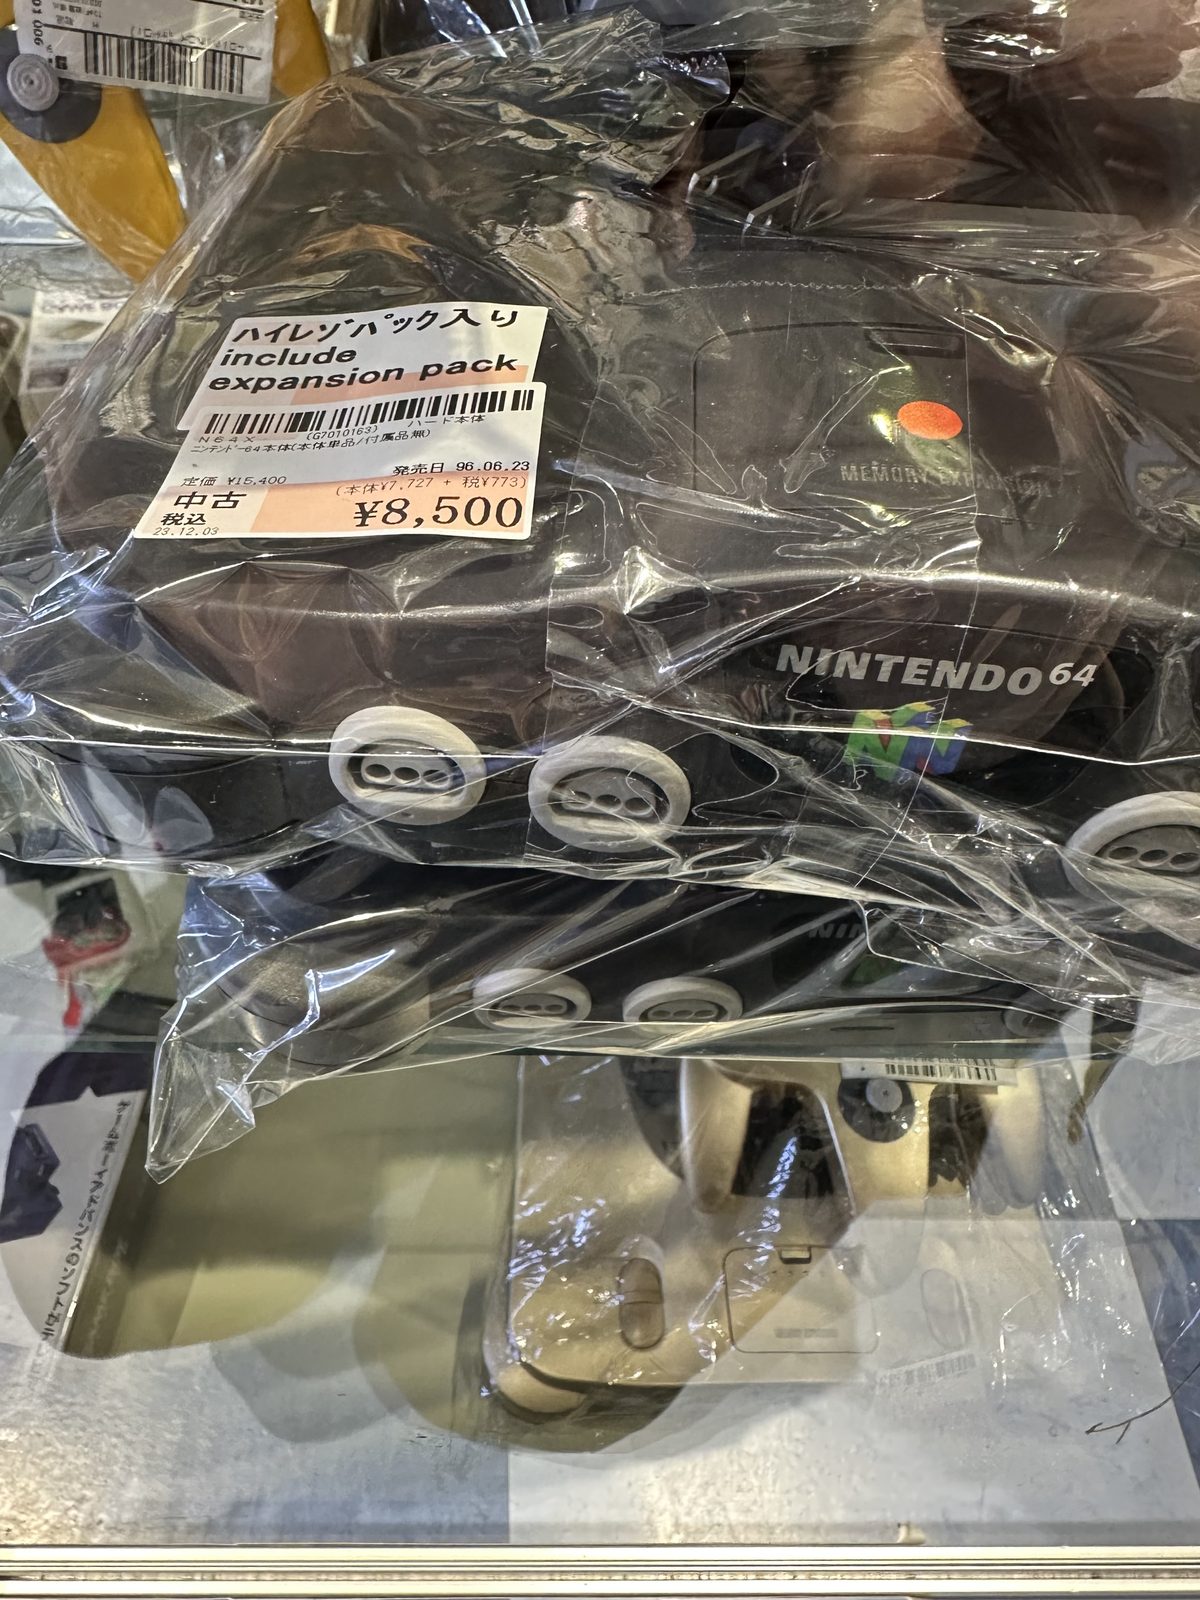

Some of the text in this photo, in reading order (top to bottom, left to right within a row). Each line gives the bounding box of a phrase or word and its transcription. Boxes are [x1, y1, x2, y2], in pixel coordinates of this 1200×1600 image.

[232, 308, 519, 343] ハイレゾパック入り
[219, 346, 357, 367] include
[208, 354, 518, 394] expansion pack
[407, 414, 486, 428] ハード本体
[306, 425, 378, 441] (G7010163)
[392, 461, 530, 476] 発売日 96.06.23
[840, 464, 928, 483] MEMORY
[181, 475, 287, 487] 定価 ¥15,400
[174, 491, 247, 510] 中古
[161, 512, 206, 526] 税込
[354, 496, 522, 529] ¥8,500
[153, 527, 219, 536] 23.12.03
[776, 644, 1097, 696] NINTENDO 64
